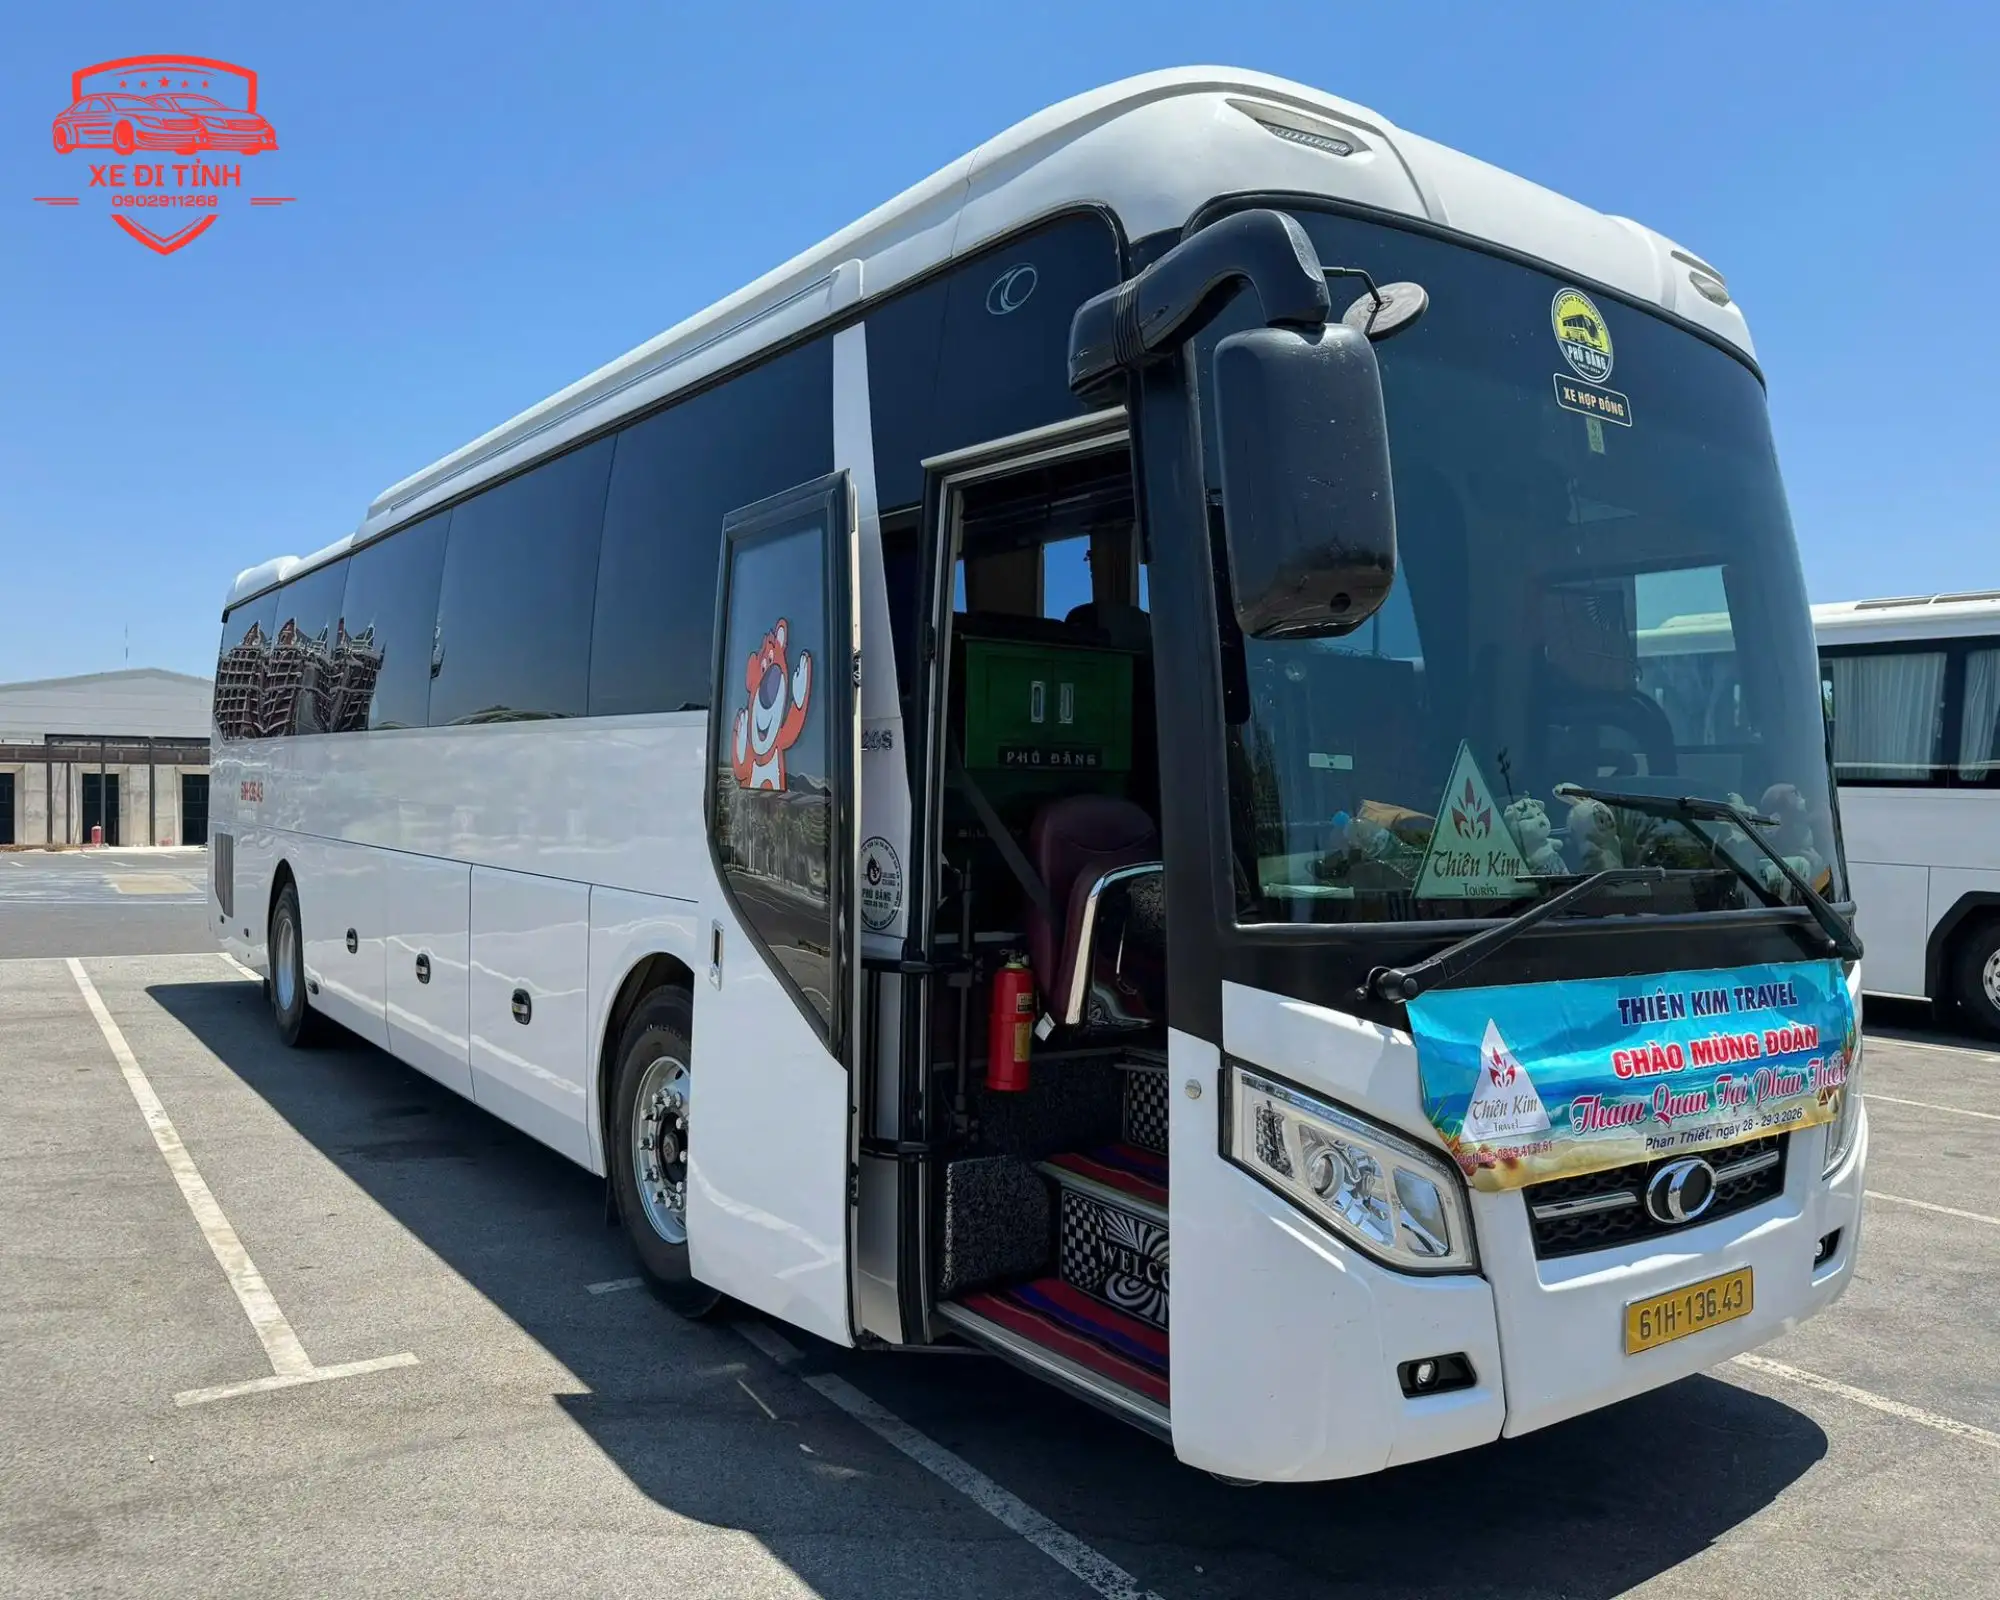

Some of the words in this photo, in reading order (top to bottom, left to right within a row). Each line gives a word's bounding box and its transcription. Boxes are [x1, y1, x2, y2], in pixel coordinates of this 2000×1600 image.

[1563, 387, 1577, 402] XE
[1432, 849, 1480, 878] Thiên
[1485, 850, 1521, 877] Kim
[1618, 986, 1686, 1025] THIÊN
[1691, 988, 1730, 1017] KIM
[1734, 982, 1798, 1012] TRAVEL
[1612, 1040, 1685, 1079] CHÀO
[1689, 1030, 1760, 1069] MỪNG
[1763, 1021, 1819, 1056] ĐOÀN
[1473, 1099, 1508, 1120] Thiên
[1512, 1095, 1538, 1116] Kim
[1569, 1093, 1646, 1135] Tham
[1652, 1083, 1709, 1129] Quan
[1753, 1065, 1803, 1110] Phan
[1646, 1136, 1675, 1151] Phan
[1743, 1118, 1754, 1131] 28
[1640, 1280, 1743, 1340] 61H-136.43
